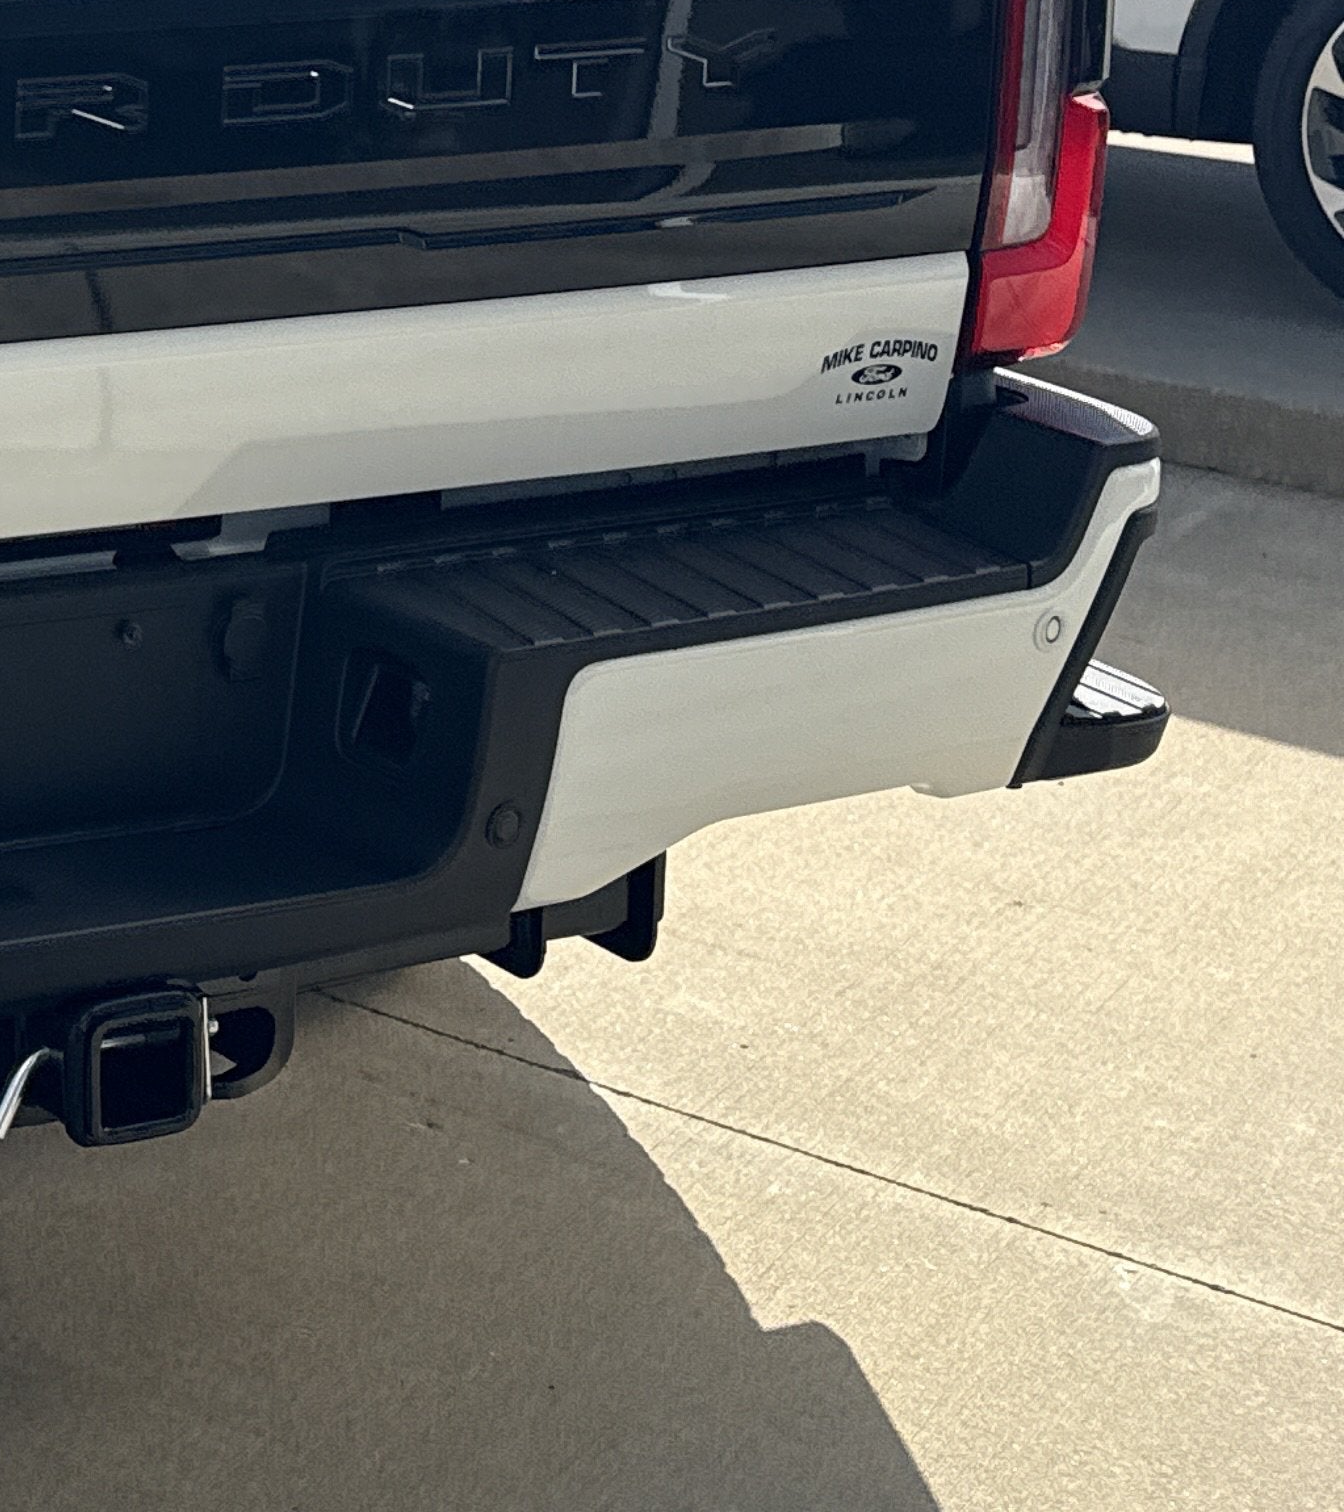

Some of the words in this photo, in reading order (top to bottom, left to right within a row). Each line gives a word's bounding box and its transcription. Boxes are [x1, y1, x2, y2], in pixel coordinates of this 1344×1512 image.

[222, 27, 779, 127] DUTY
[820, 344, 865, 373] MIKE
[869, 340, 939, 362] CARPINO
[835, 387, 908, 405] LINCOLN
